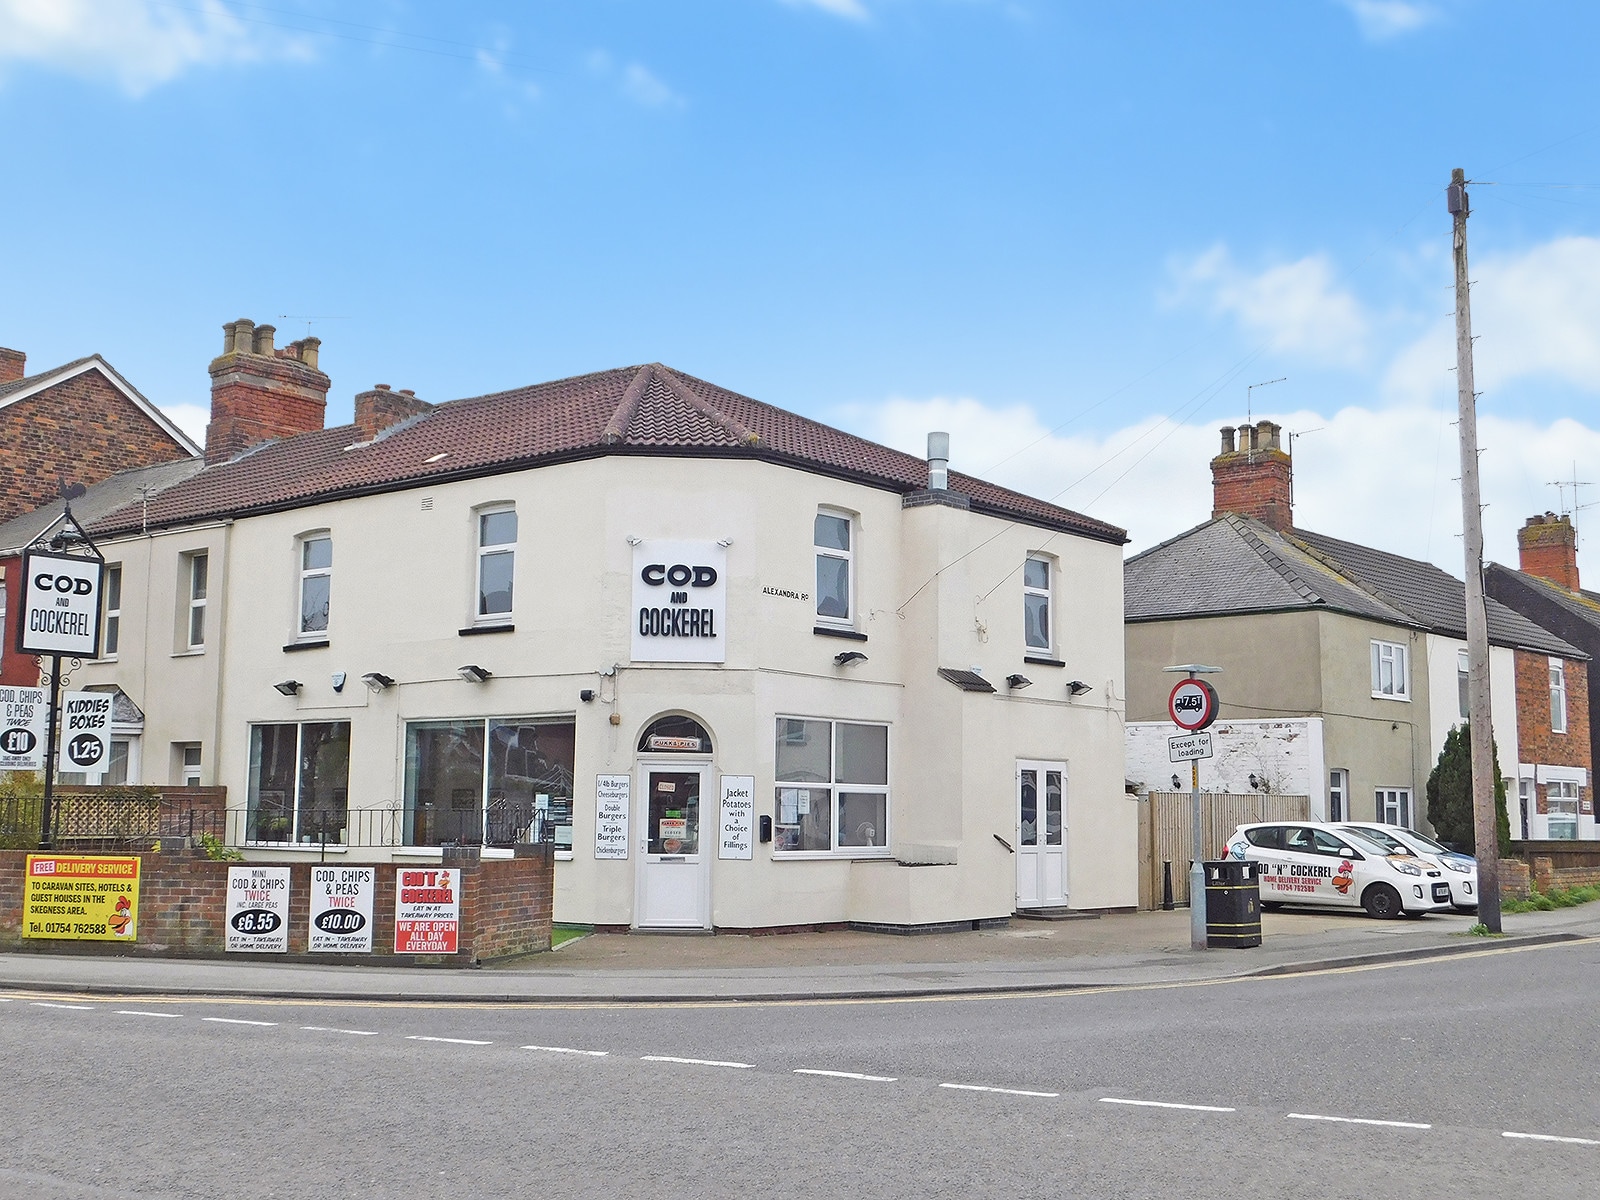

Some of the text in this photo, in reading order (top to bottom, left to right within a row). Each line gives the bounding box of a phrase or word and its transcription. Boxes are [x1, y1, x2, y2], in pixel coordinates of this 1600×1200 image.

[641, 564, 718, 587] COD
[34, 573, 93, 596] COD
[670, 591, 688, 604] AND
[762, 586, 800, 600] ALEXANDRA
[55, 597, 70, 608] AND
[30, 608, 90, 637] COCKEREL
[639, 607, 717, 638] COCKEREL
[19, 690, 43, 704] CHIPS
[6, 703, 34, 718] & PEAS
[67, 699, 109, 714] KIDDIES
[6, 718, 33, 727] TWICE
[69, 715, 105, 730] BOXES
[7, 731, 29, 752] £10
[1171, 741, 1195, 750] Except
[71, 740, 101, 759] 1.25
[1178, 748, 1204, 757] loading
[611, 781, 628, 789] Burgers
[598, 790, 628, 799] Cheeseburgers
[726, 789, 748, 799] Jacket
[722, 799, 751, 808] Potatoes
[598, 812, 626, 821] Burgers
[603, 825, 621, 834] Triple
[725, 824, 748, 832] Choice
[597, 833, 625, 843] Burgers
[596, 847, 626, 855] Chickenburgers
[724, 841, 747, 850] Fillings
[35, 863, 133, 874] FREE DELIVERY SERVICE
[251, 870, 267, 878] MINI
[1259, 863, 1269, 874] OD
[1290, 864, 1332, 878] COCKEREL
[316, 870, 370, 882] COD, CHIPS
[1263, 875, 1277, 883] HOME
[1301, 877, 1322, 886] SERVICE
[32, 882, 132, 892] TO CARAVAN SITES, HOTELS &
[232, 879, 285, 889] COD & CHIPS
[325, 883, 359, 895] & PEAS
[31, 894, 106, 903] GUEST HOUSES IN THE
[244, 890, 270, 901] TWICE
[401, 889, 454, 904] COCKEREL
[328, 896, 355, 908] TWICE
[30, 906, 87, 915] SKEGNESS AREA.
[237, 913, 274, 931] £6.55
[321, 914, 361, 929] £10.00
[399, 922, 455, 932] WE ARE OPEN
[30, 922, 106, 934] Tel. 01754 762588
[410, 932, 444, 941] ALL DAY
[406, 941, 448, 951] EVERYDAY
